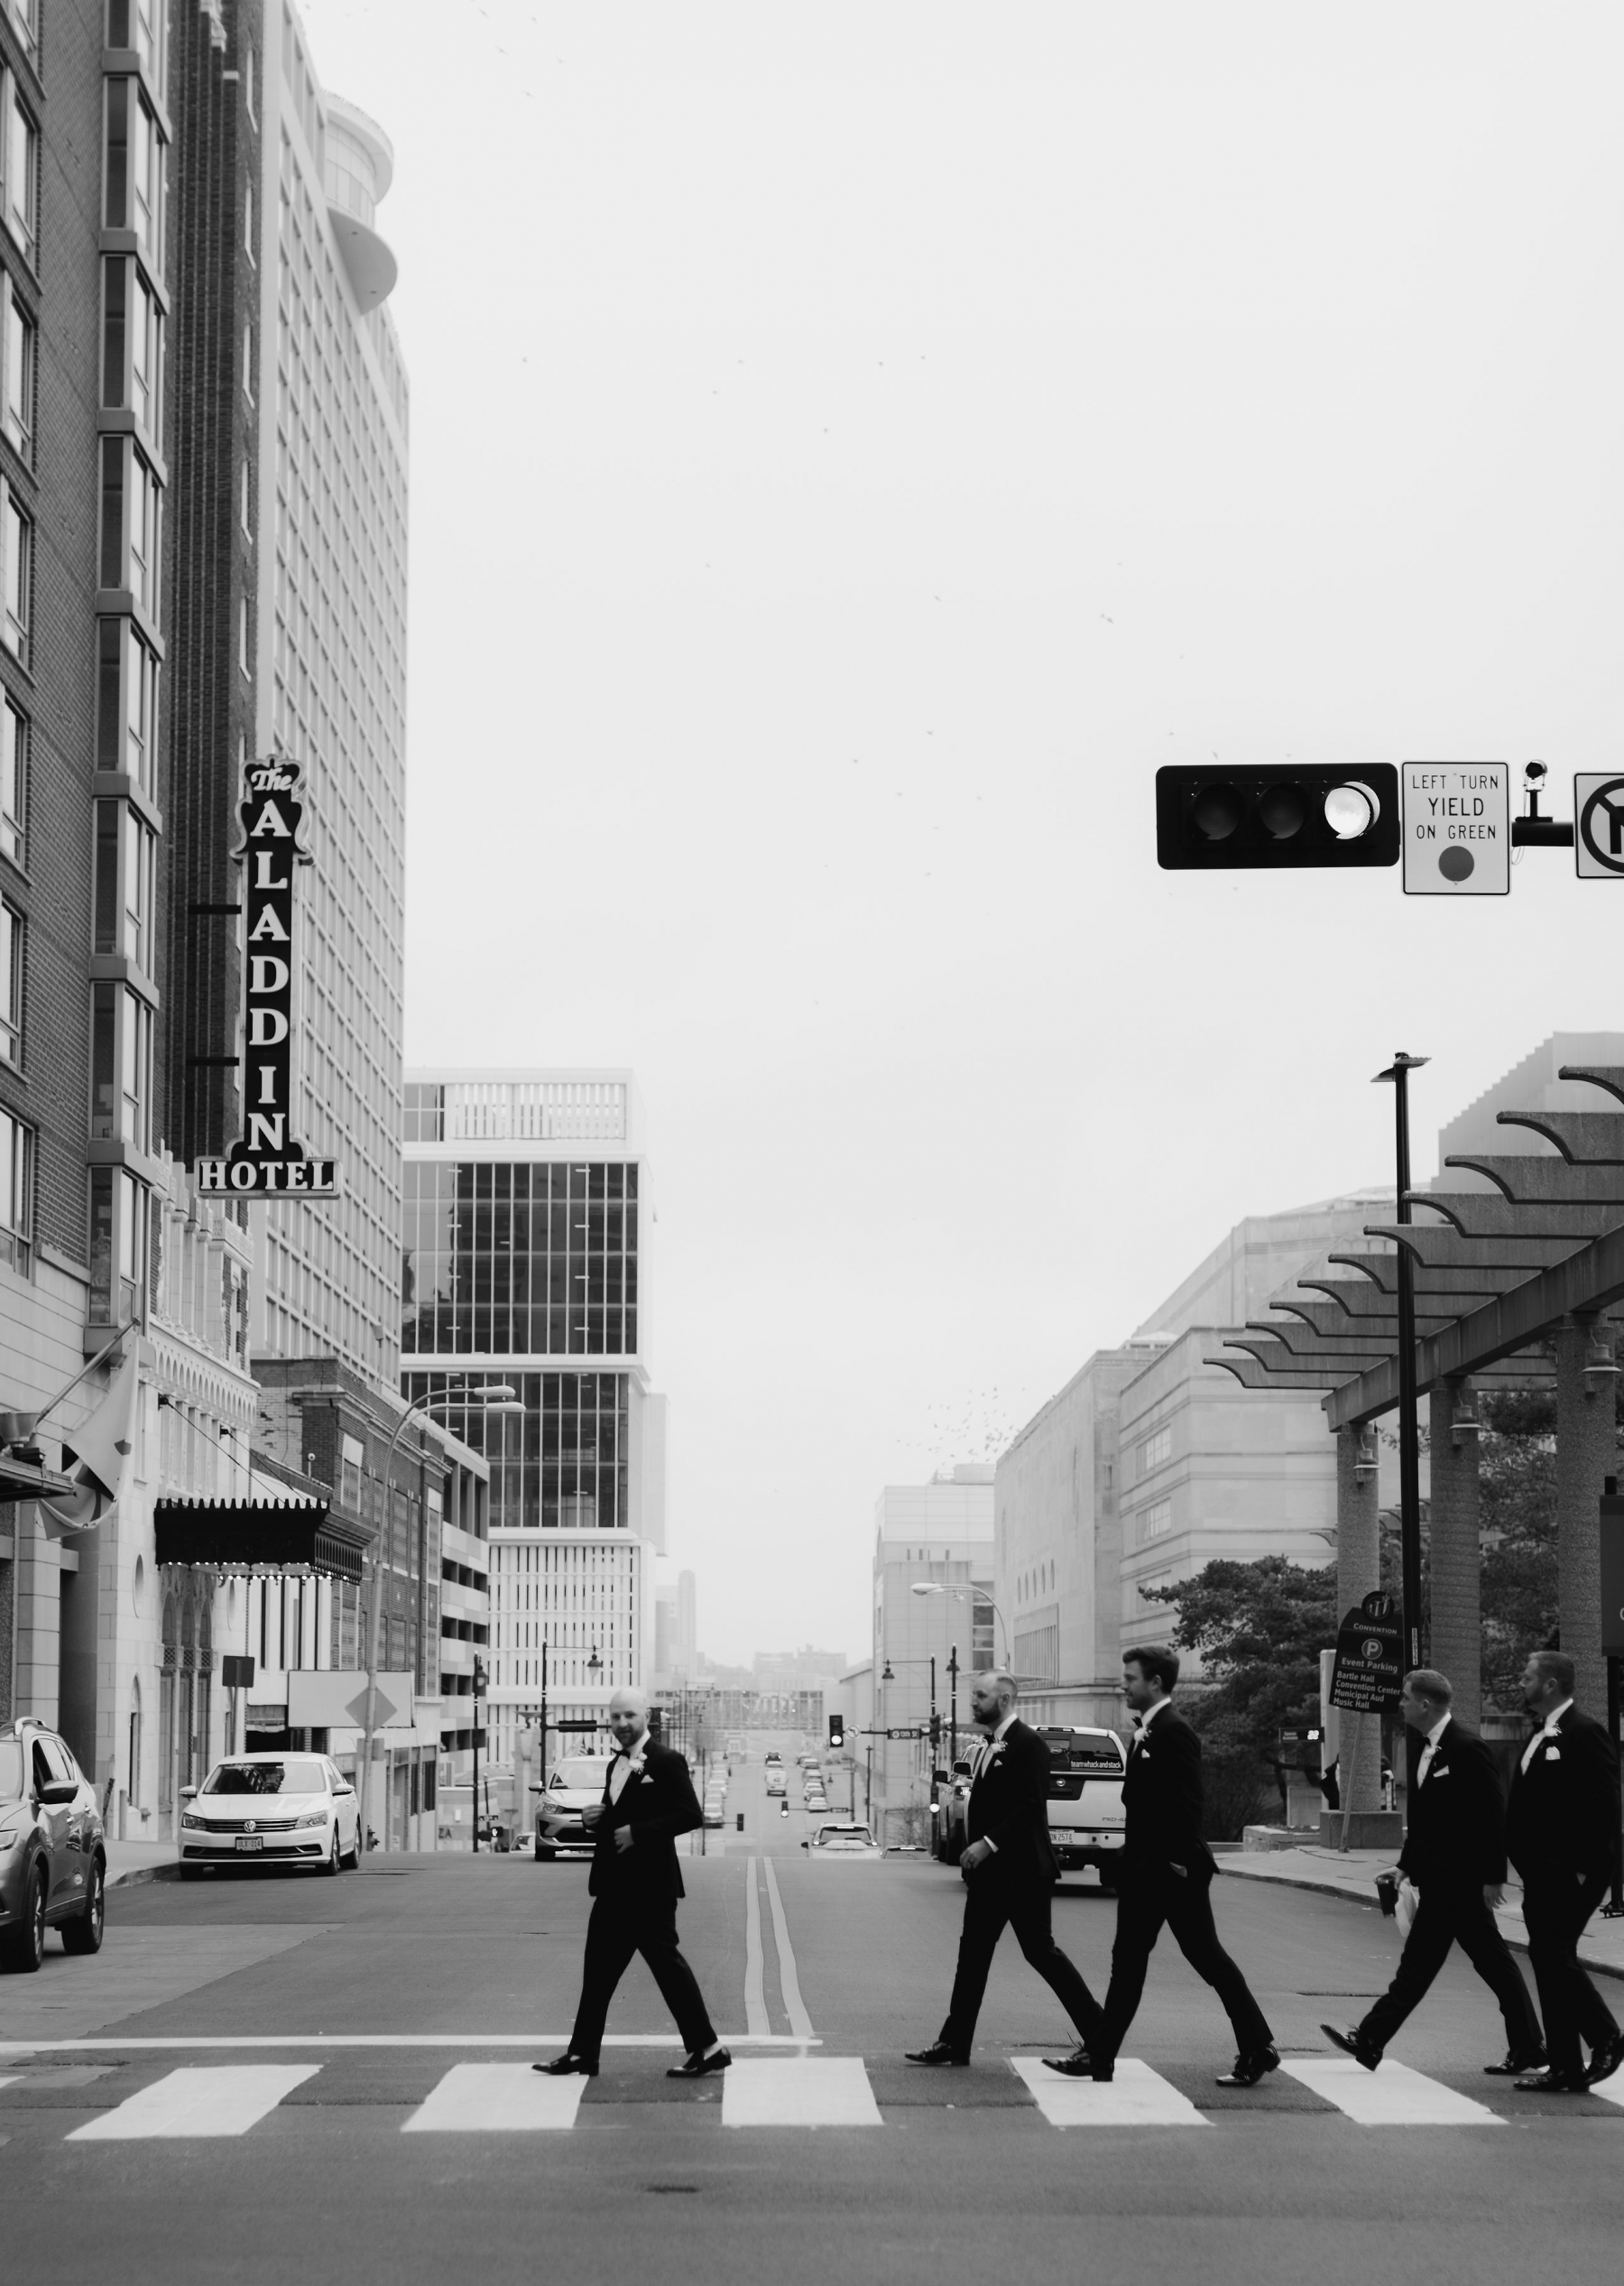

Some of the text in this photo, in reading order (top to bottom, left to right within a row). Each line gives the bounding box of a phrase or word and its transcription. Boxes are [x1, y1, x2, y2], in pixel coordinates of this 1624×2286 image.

[251, 769, 291, 791] The
[1412, 775, 1499, 790] LEFT TURN
[1427, 797, 1485, 817] YIELD
[1416, 825, 1497, 839] ON GREEN
[248, 799, 291, 1152] ALADDIN
[199, 1161, 334, 1190] HOTEL
[1353, 1623, 1398, 1634] CONVENTION
[1367, 1641, 1379, 1657] P
[1342, 1657, 1398, 1674] Event Parking
[1337, 1671, 1375, 1683] Bartle Hall
[1334, 1689, 1385, 1702] Municipal Aud
[1336, 1680, 1401, 1696] Convention Center
[1333, 1697, 1370, 1709] Music Hall
[1057, 1833, 1072, 1841] 2574
